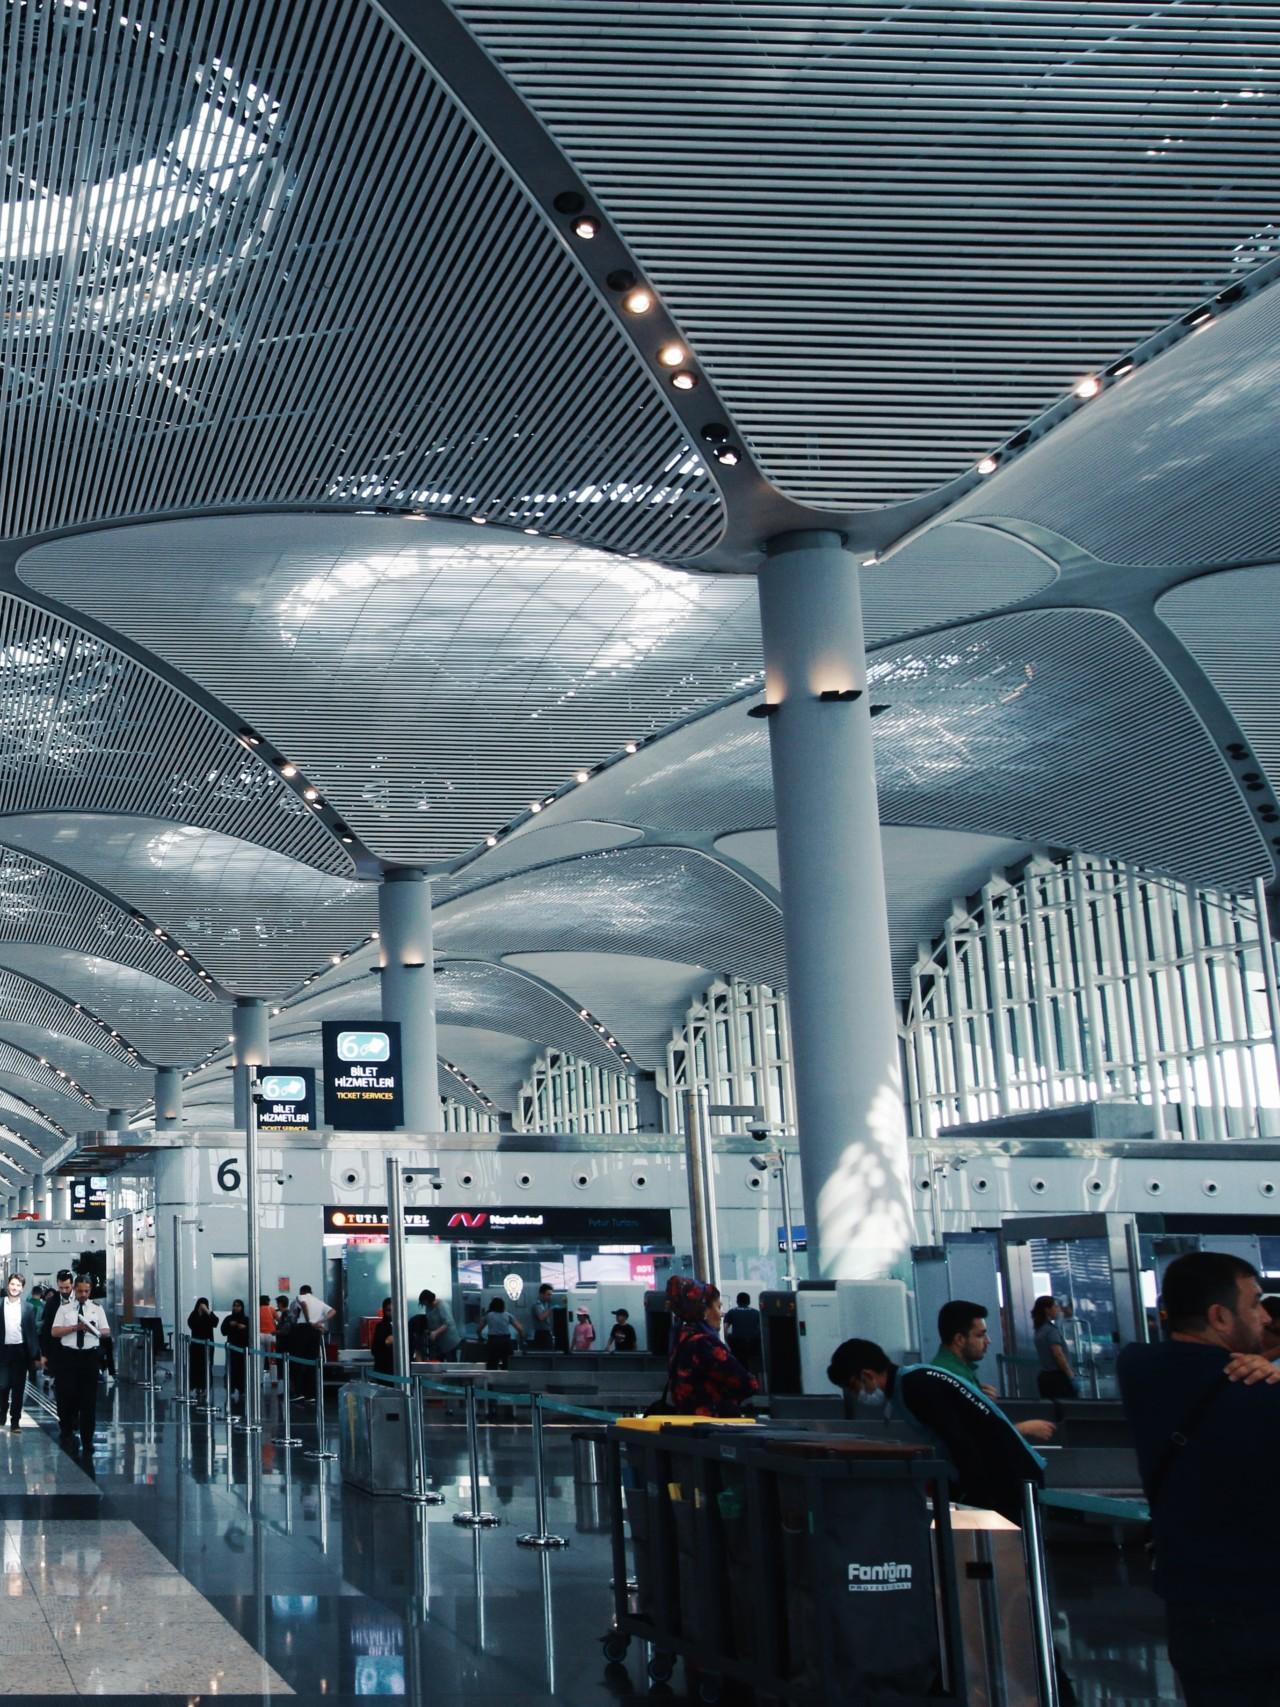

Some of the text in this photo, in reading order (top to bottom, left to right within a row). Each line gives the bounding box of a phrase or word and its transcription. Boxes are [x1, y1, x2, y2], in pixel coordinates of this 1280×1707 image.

[342, 1035, 359, 1058] 6
[350, 1064, 378, 1077] BİLET
[266, 1078, 281, 1098] 6
[334, 1075, 394, 1088] HİZMETLERİ
[361, 1092, 394, 1100] SERVICES
[272, 1103, 296, 1114] BİLET
[260, 1112, 309, 1123] HİZMETLERİ
[217, 1158, 241, 1192] 6
[489, 1214, 543, 1225] Nordwind
[35, 1232, 46, 1248] 5
